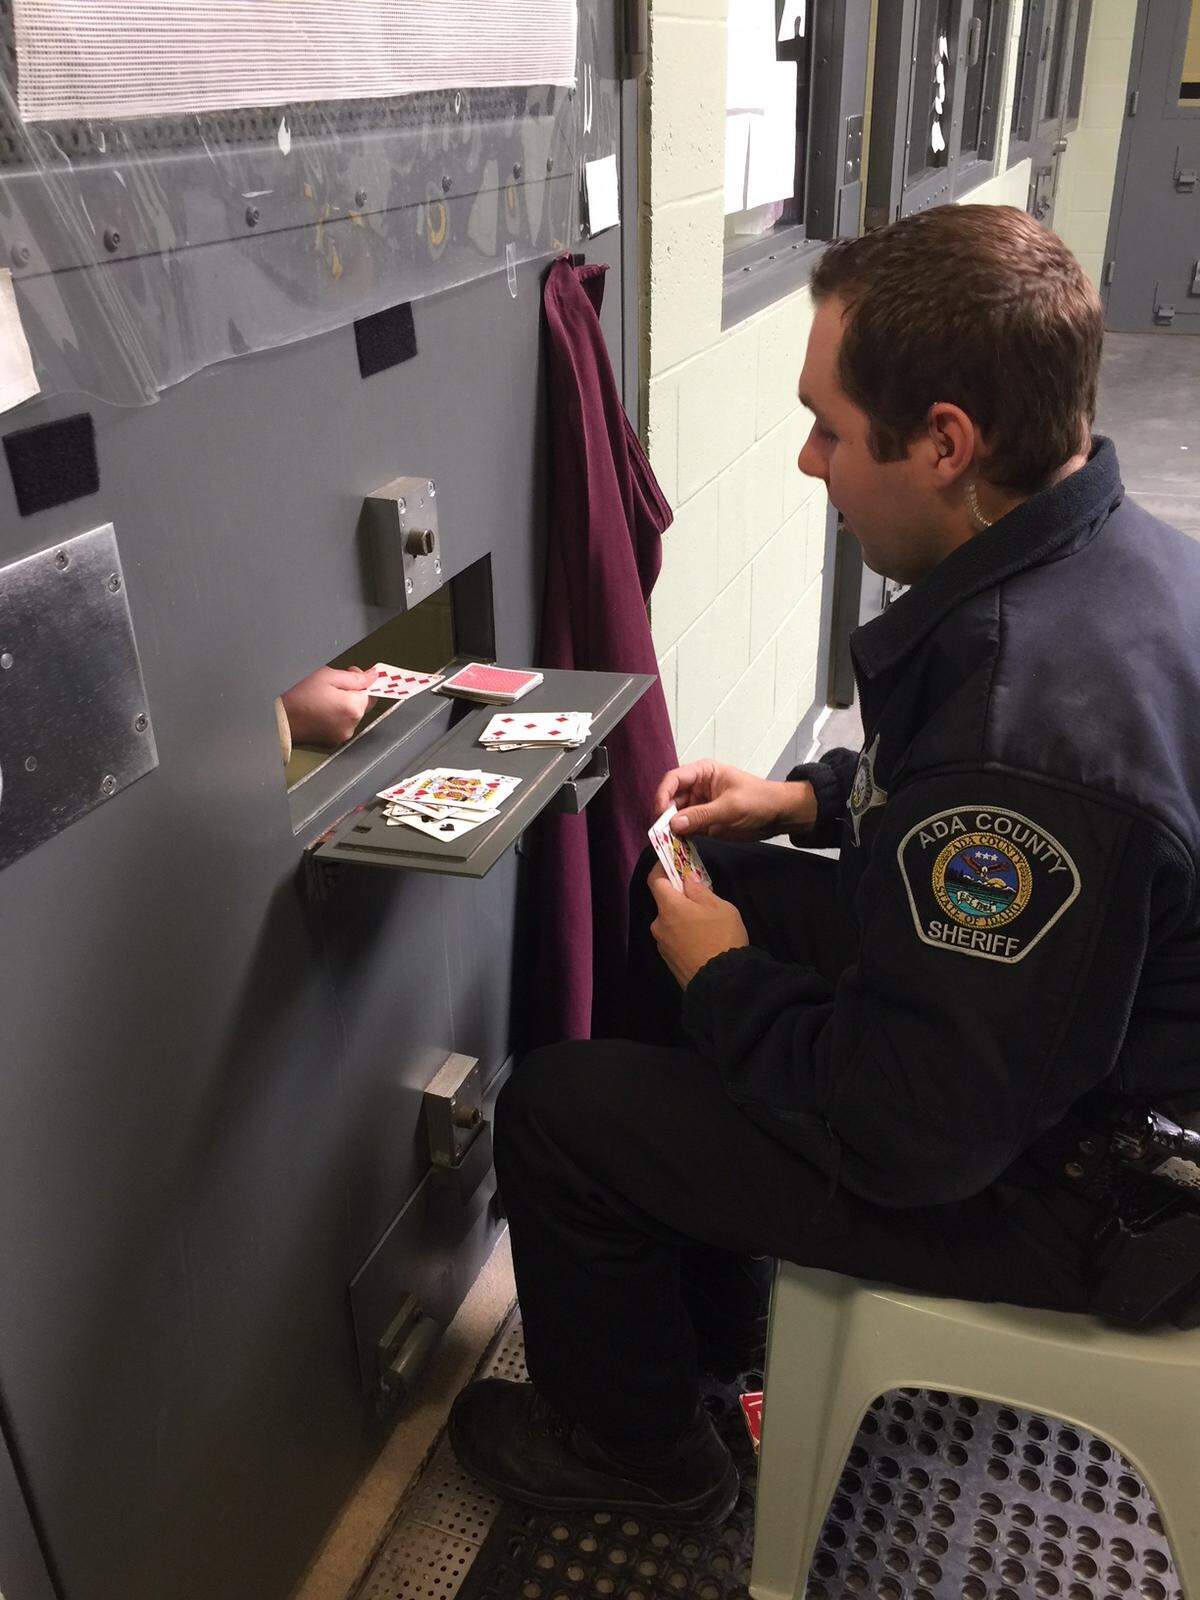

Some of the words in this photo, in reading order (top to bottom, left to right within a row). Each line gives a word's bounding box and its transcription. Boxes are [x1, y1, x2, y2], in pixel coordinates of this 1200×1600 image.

[918, 815, 967, 849] ADA
[976, 813, 1067, 874] COUNTY
[953, 836, 974, 851] ADA
[979, 836, 1026, 865] COUNTY
[928, 920, 1020, 956] SHERIFF
